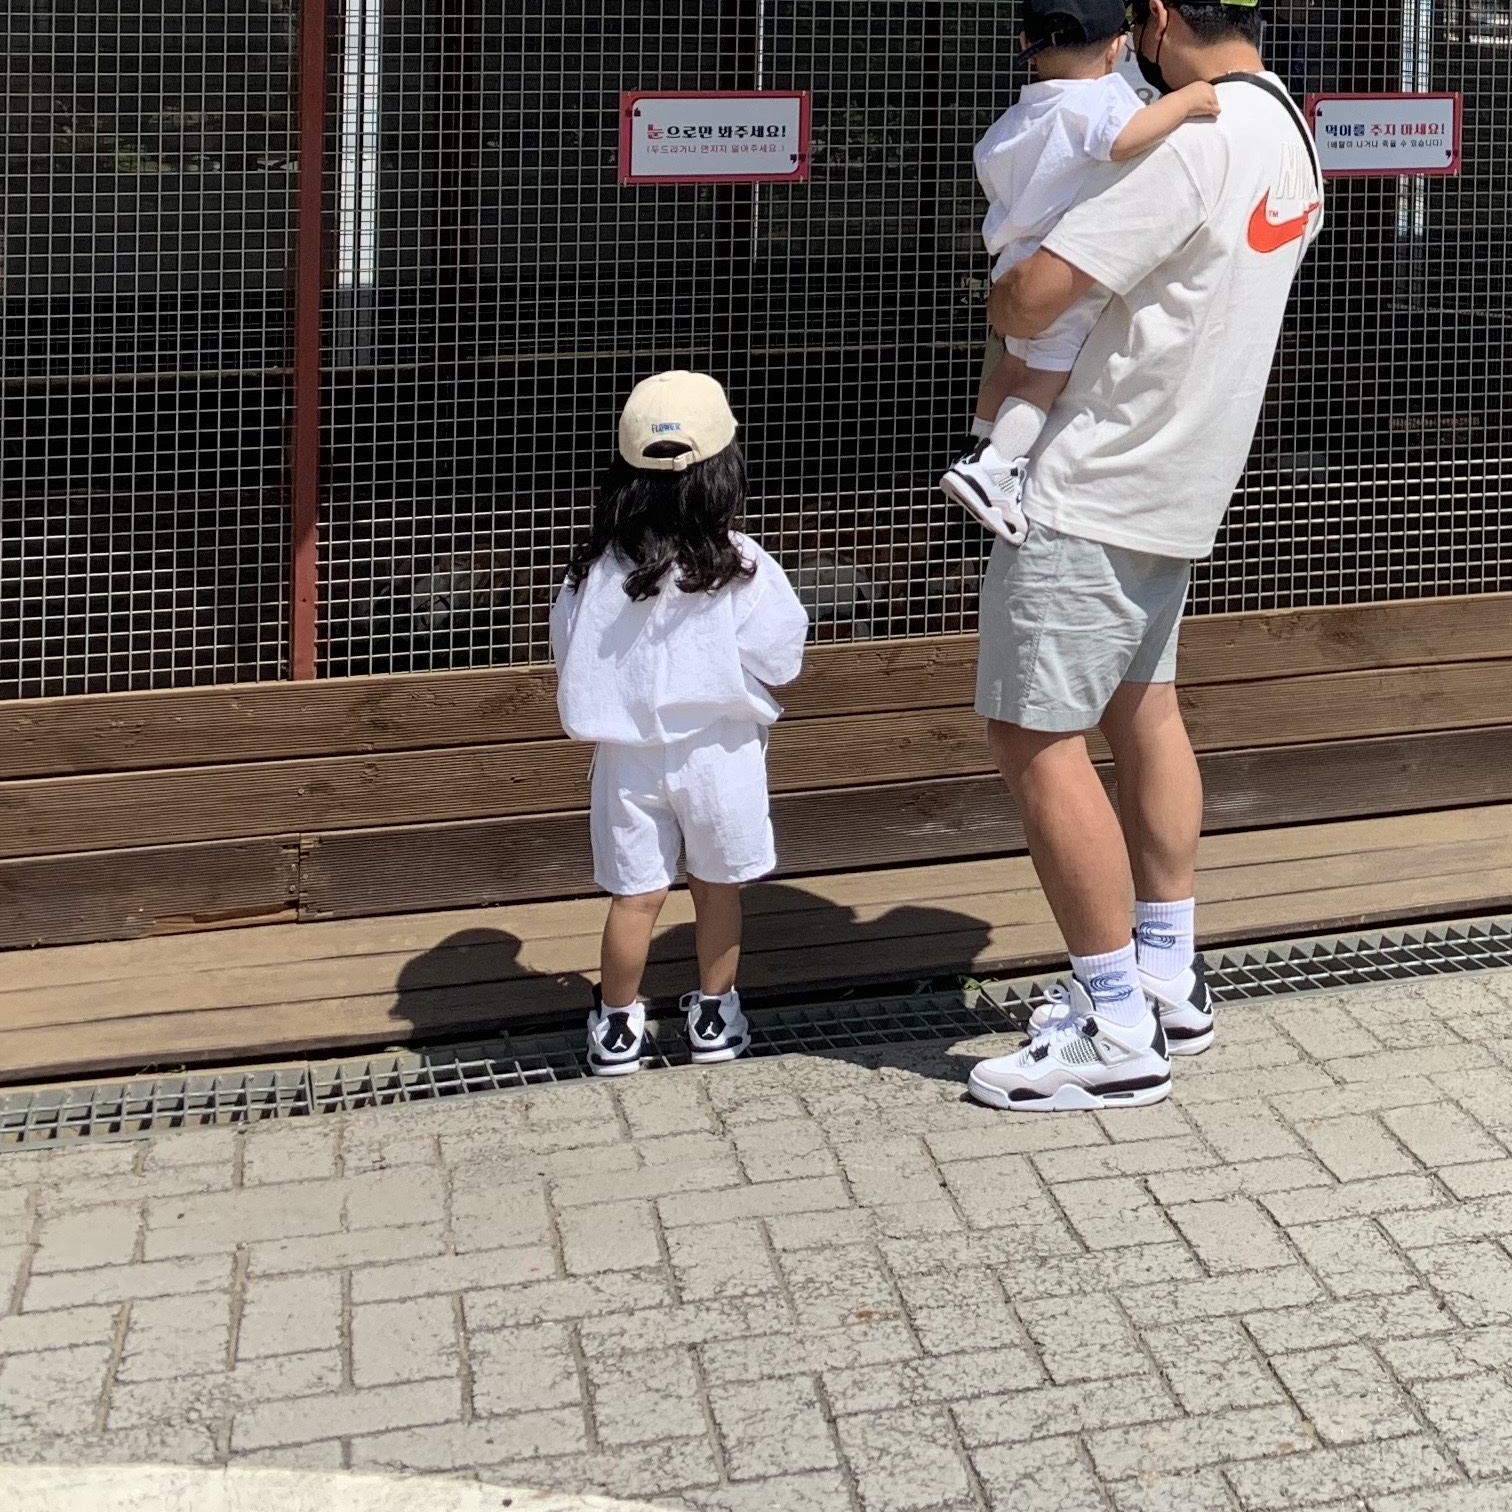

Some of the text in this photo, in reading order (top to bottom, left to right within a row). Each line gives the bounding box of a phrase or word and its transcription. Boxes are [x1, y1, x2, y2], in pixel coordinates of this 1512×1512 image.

[646, 123, 787, 140] 눈으로만 봐주세요!
[1324, 122, 1445, 138] 먹이를 주지 마세요!
